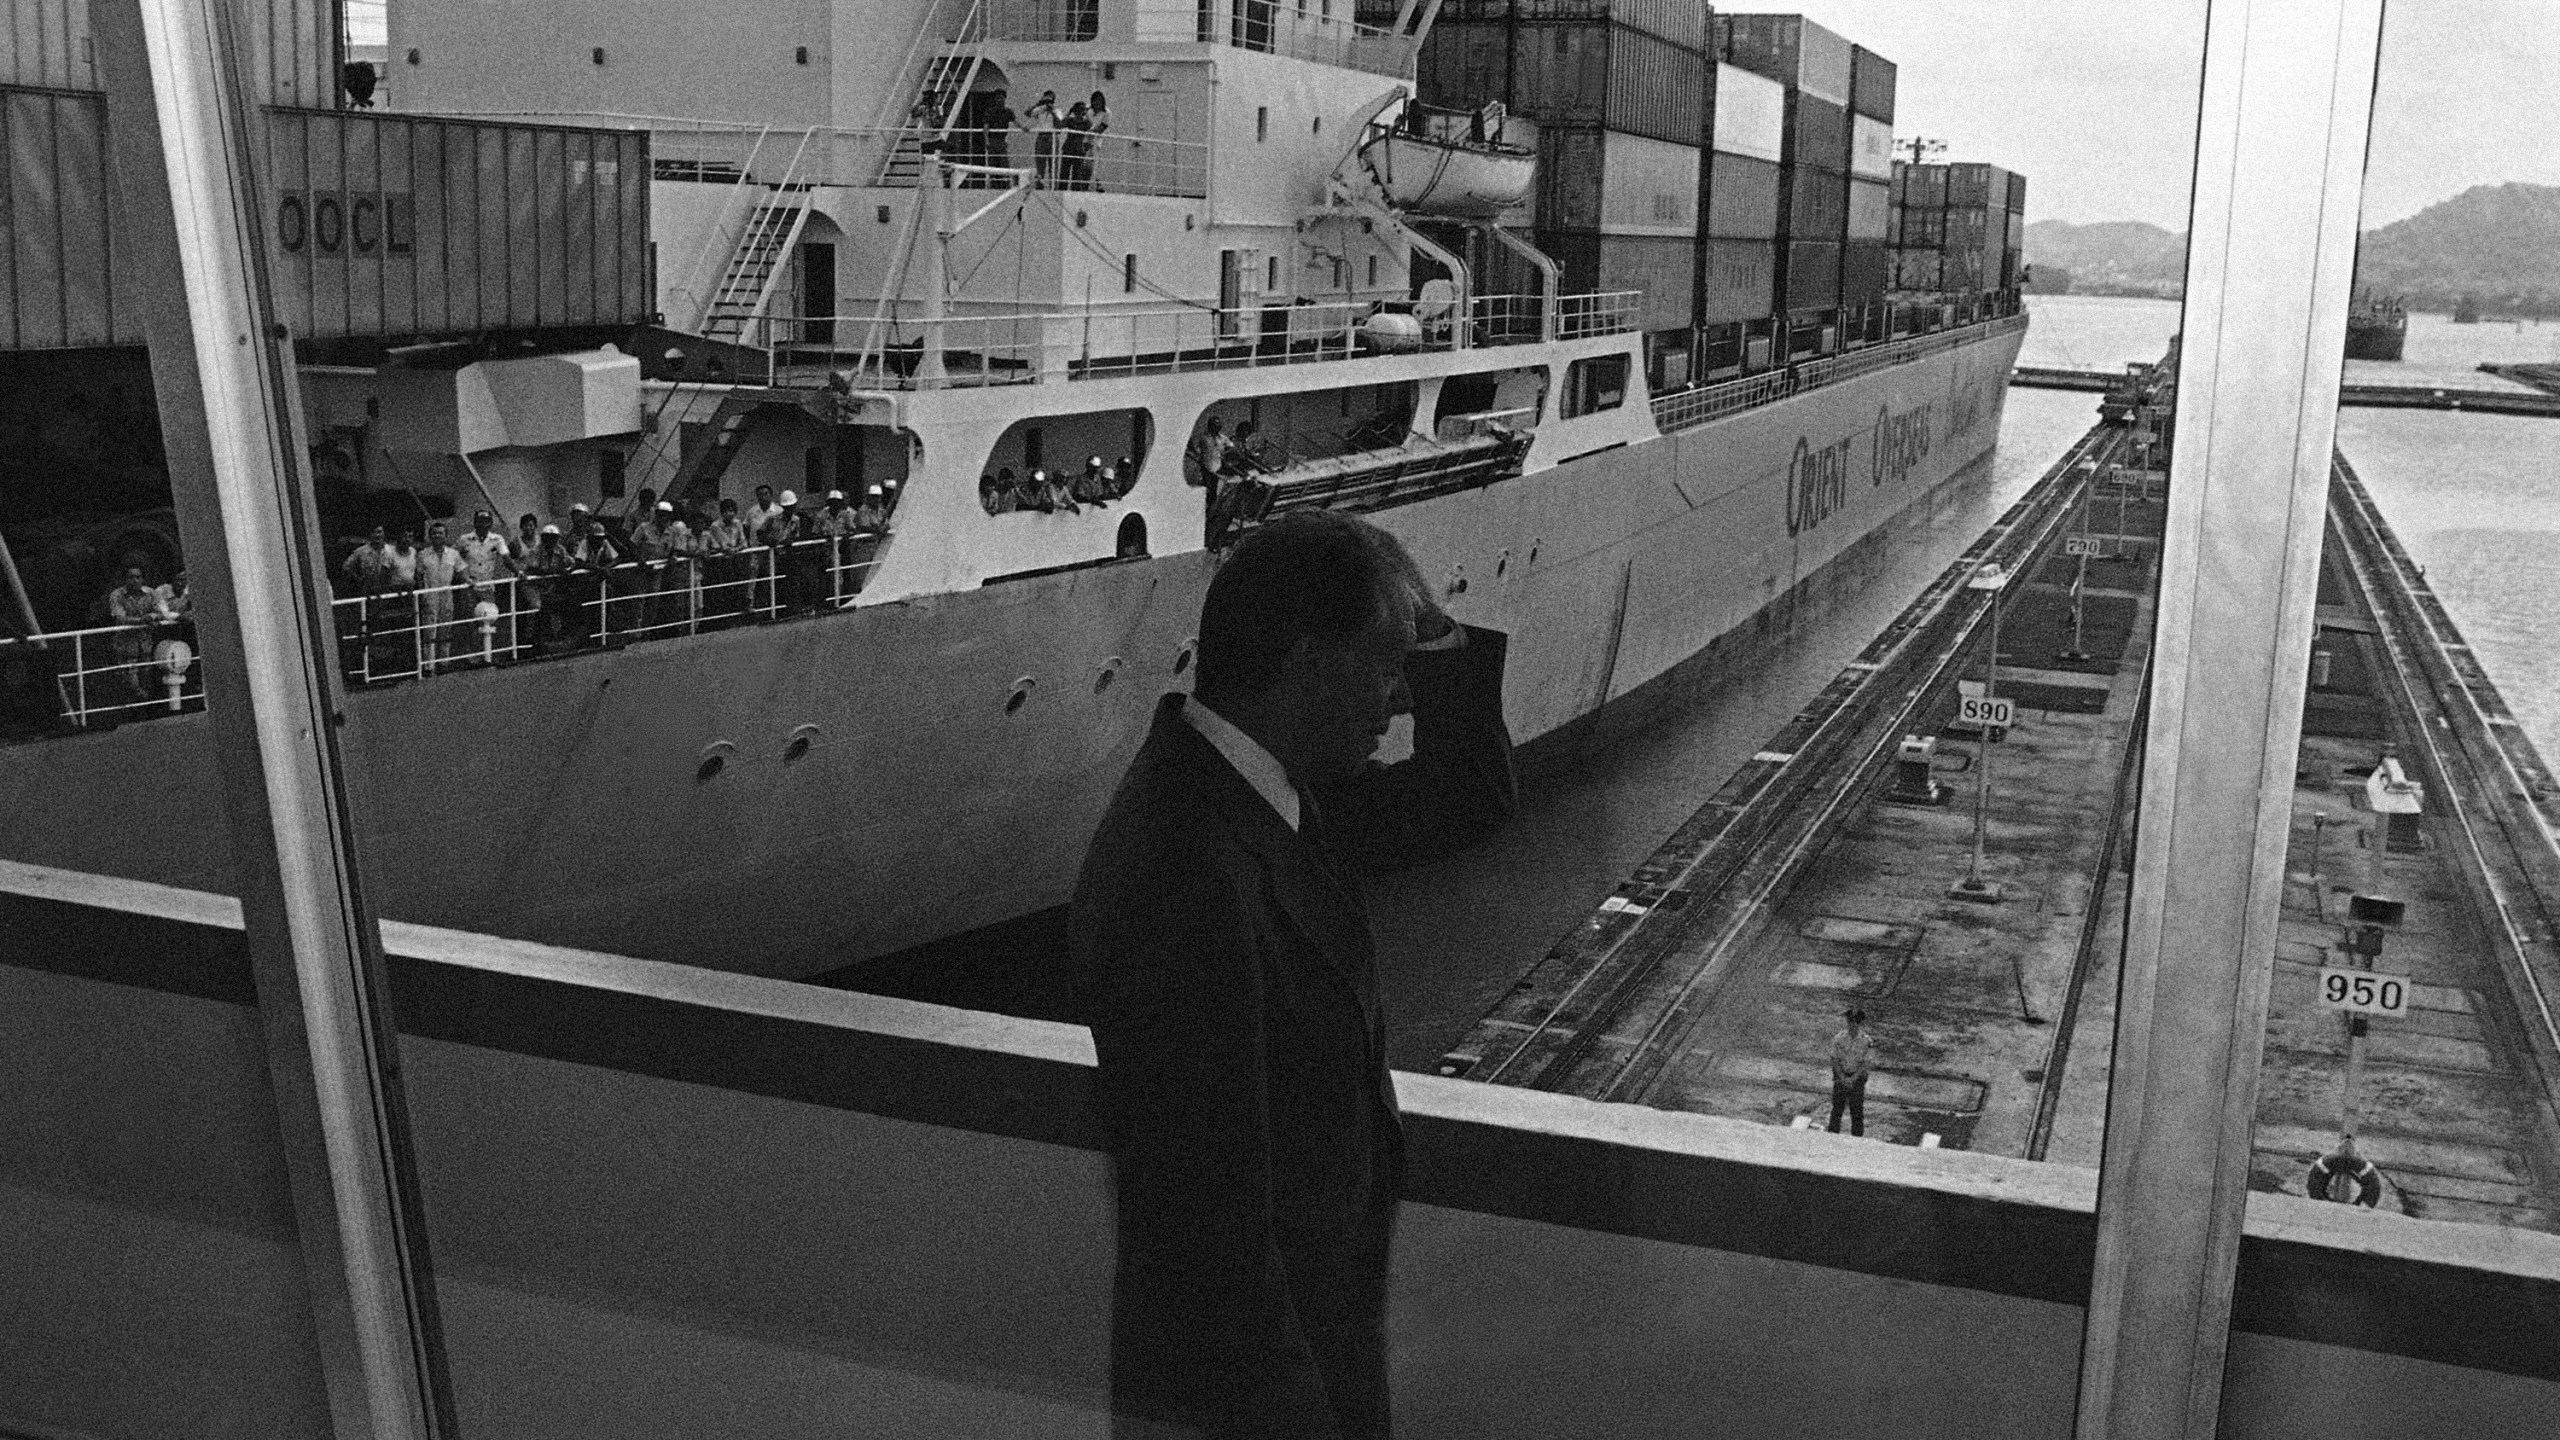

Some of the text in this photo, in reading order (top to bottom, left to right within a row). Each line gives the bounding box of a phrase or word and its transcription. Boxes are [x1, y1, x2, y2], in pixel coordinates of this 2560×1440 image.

[278, 196, 410, 252] OOCL
[2068, 539, 2098, 553] 790
[1964, 700, 2008, 722] 890
[2326, 974, 2402, 1010] 950
